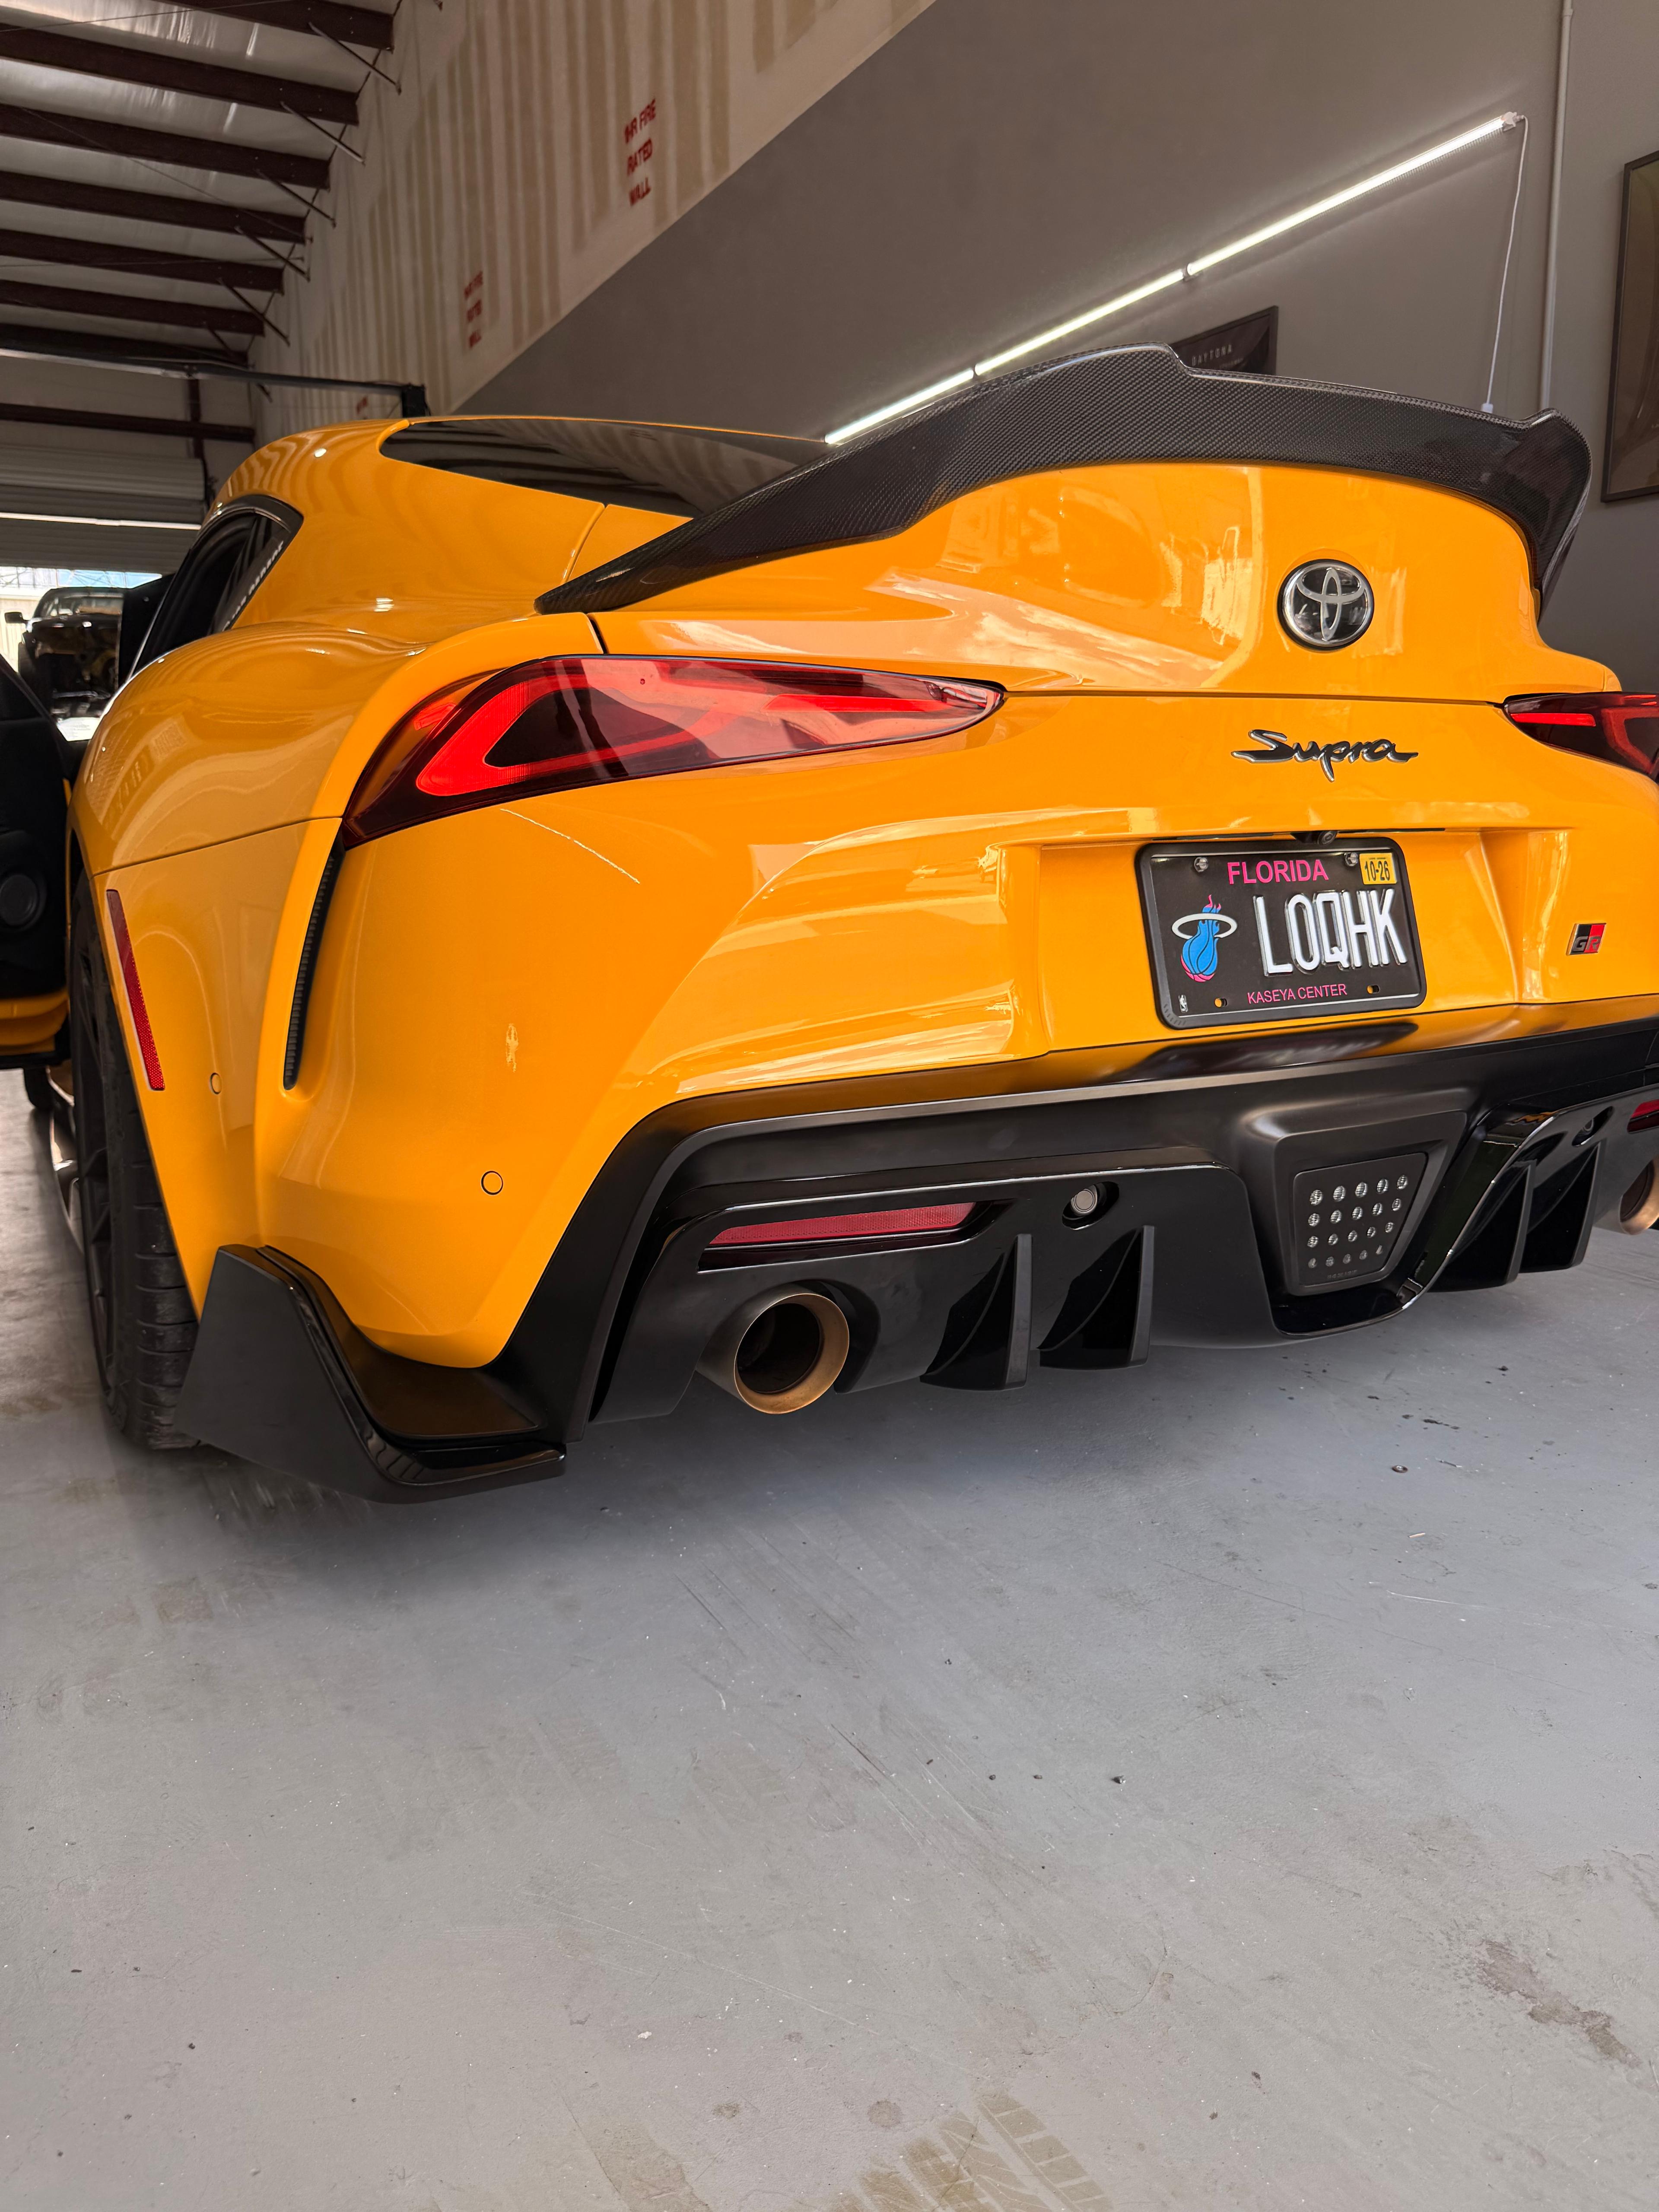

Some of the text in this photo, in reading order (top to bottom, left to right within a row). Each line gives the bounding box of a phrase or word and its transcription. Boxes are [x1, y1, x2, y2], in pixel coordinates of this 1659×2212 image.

[627, 137, 652, 176] RATED
[1231, 729, 1418, 782] Supra
[1227, 859, 1329, 884] FLORIDA
[1364, 861, 1390, 881] 10-26
[1572, 936, 1601, 951] GR
[1247, 983, 1348, 1004] KASEYA CENTER
